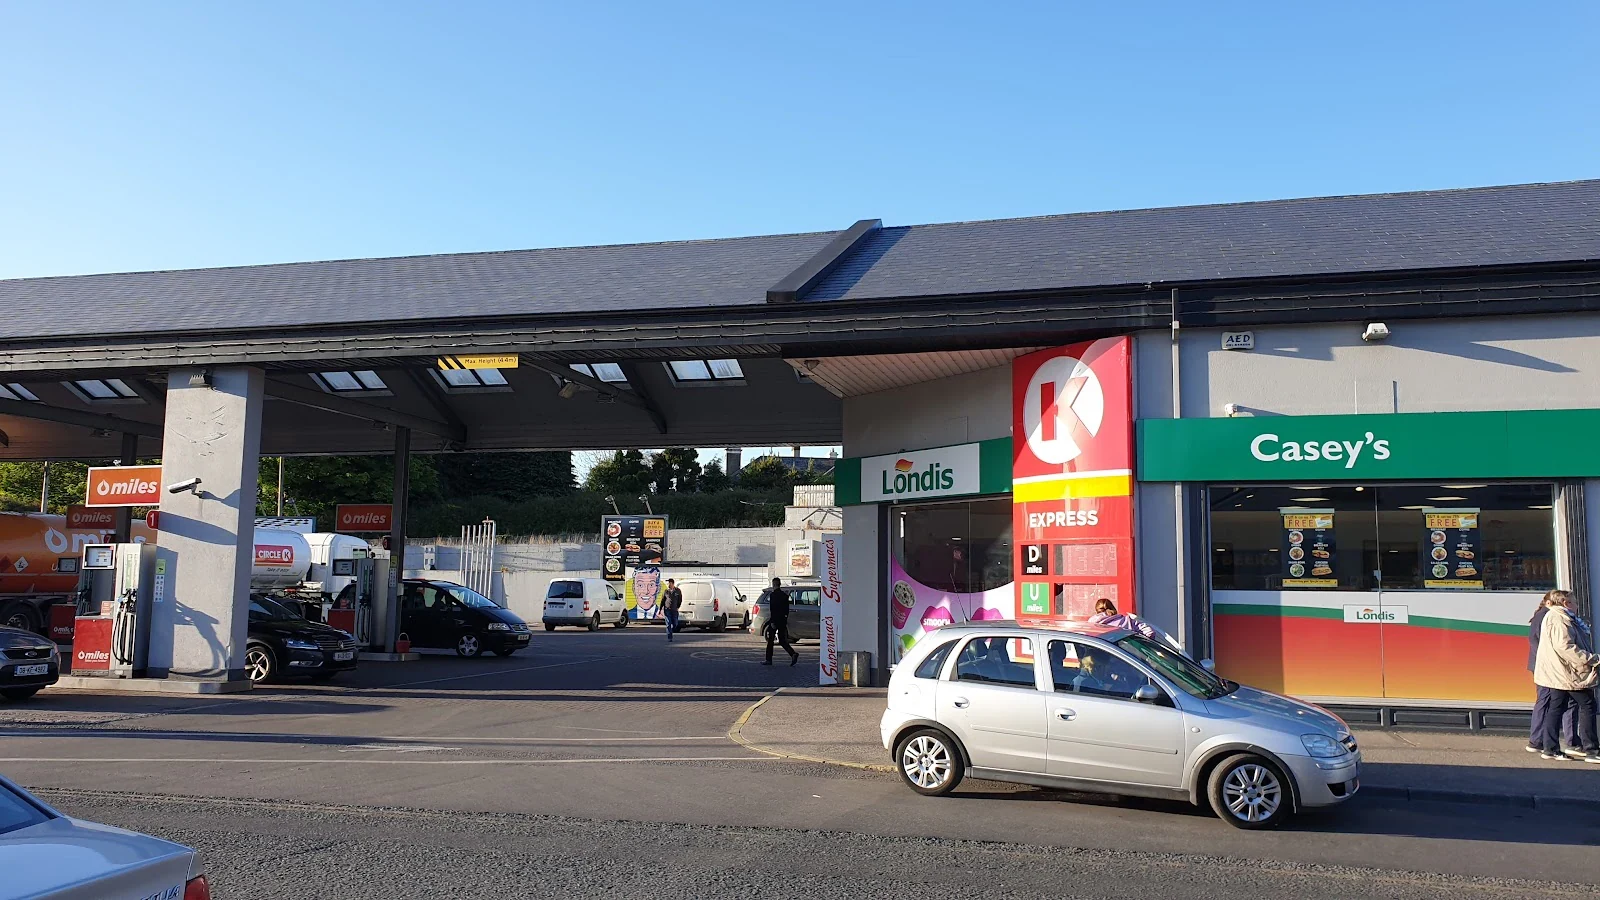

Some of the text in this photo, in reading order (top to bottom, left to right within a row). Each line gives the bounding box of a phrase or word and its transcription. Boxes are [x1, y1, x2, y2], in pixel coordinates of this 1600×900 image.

[1225, 334, 1250, 344] AED
[1036, 370, 1096, 455] K
[1250, 431, 1391, 469] Casey's
[882, 462, 954, 495] Londis
[110, 478, 158, 495] miles
[81, 512, 112, 523] miles
[149, 513, 156, 527] 1
[352, 512, 387, 524] miles
[1029, 509, 1099, 529] EXPRESS
[1430, 518, 1457, 527] FREE
[1288, 519, 1314, 528] FREE
[258, 549, 282, 559] CIRCLE
[1027, 545, 1040, 563] D
[1026, 565, 1043, 574] miles
[1029, 583, 1040, 601] U
[1026, 604, 1043, 613] miles
[1356, 611, 1395, 621] Londis
[85, 650, 109, 660] miles
